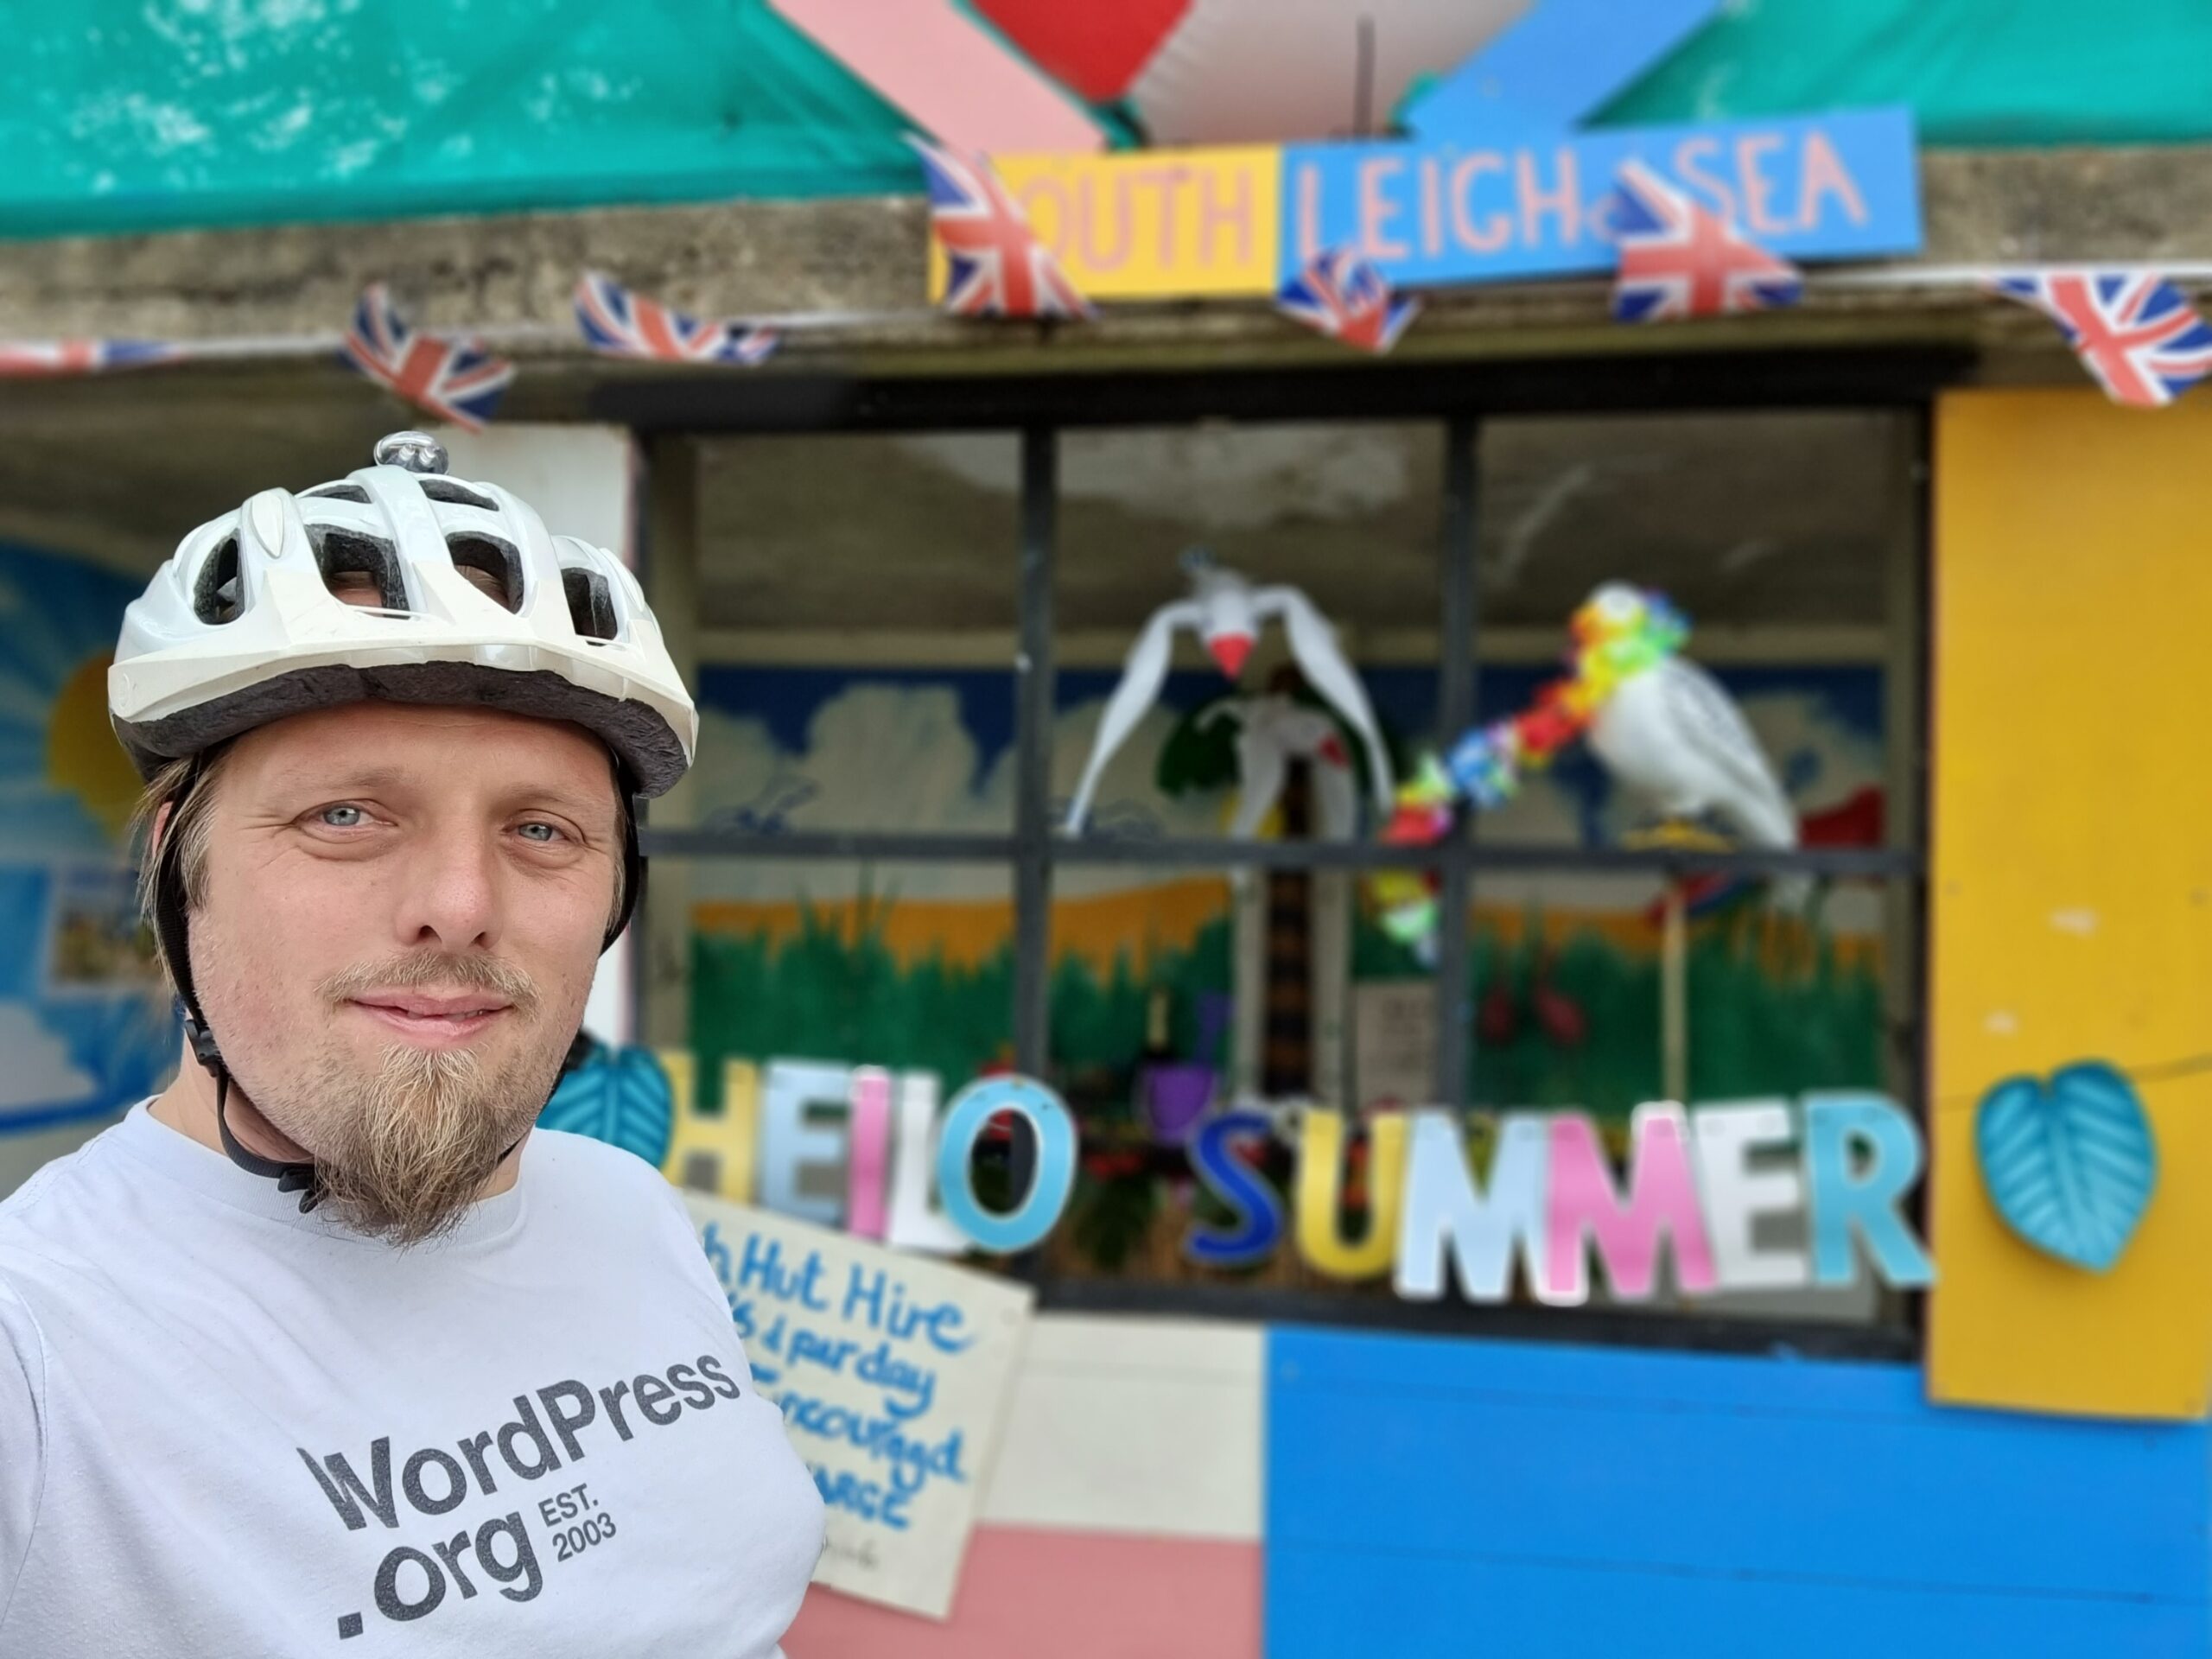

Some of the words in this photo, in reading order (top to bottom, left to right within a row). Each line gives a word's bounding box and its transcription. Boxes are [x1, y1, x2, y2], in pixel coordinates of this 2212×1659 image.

[1020, 162, 1255, 273] OUTH
[1298, 140, 1581, 264] LEIGH
[1674, 128, 1871, 236] SEA
[1185, 1089, 1938, 1306] SUMMER
[740, 1232, 829, 1313] Hut
[842, 1263, 976, 1354] Hire
[296, 1354, 741, 1531] WordPress
[854, 1341, 937, 1420] day
[537, 1483, 599, 1528] EST.
[551, 1511, 618, 1562] 2003
[337, 1510, 543, 1640] .org
